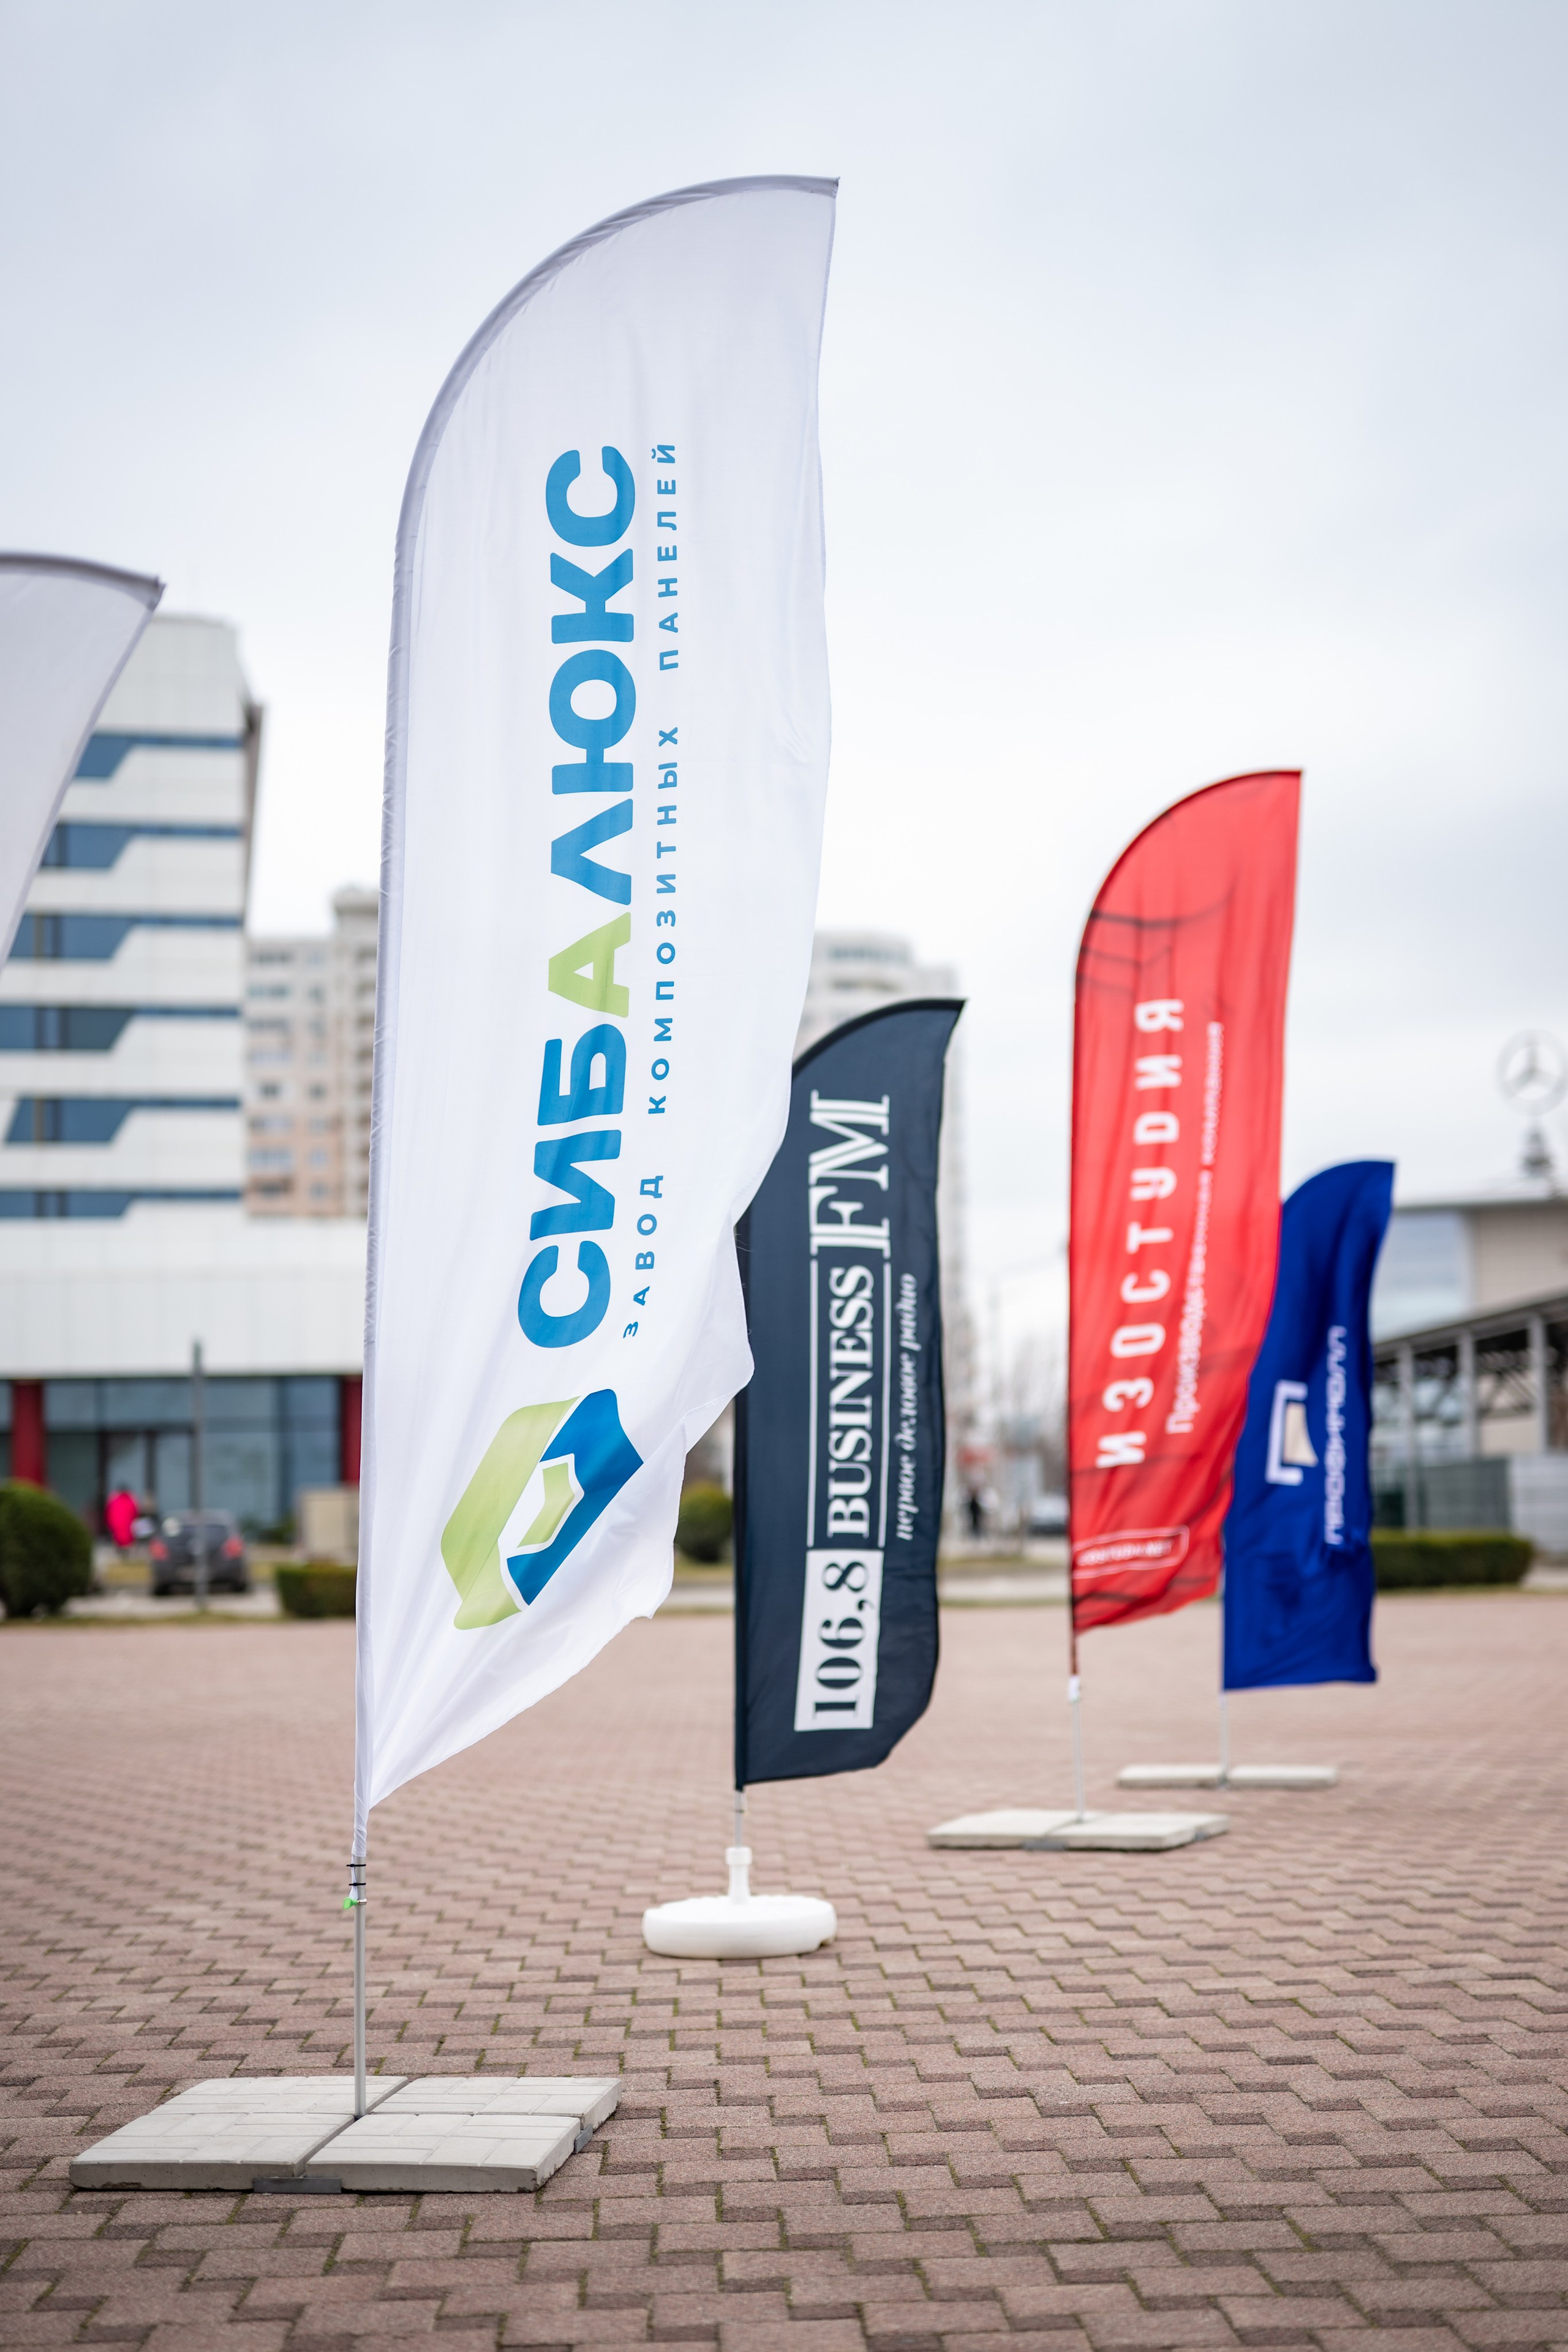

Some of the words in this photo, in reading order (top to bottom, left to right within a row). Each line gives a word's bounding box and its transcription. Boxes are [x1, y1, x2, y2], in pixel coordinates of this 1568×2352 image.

[651, 443, 679, 671] ПАНЕЛЕЙ
[518, 445, 636, 1348] СИБАЛЮКС
[647, 726, 679, 1115] КОМПОЗИТНЫХ
[623, 1174, 664, 1339] ЗАВОД
[809, 1090, 891, 1258] FM
[895, 1273, 921, 1351] радио
[826, 1265, 875, 1538] BUSINESS
[895, 1352, 918, 1451] деловое
[896, 1454, 919, 1541] первое
[812, 1561, 874, 1720] 106,8
